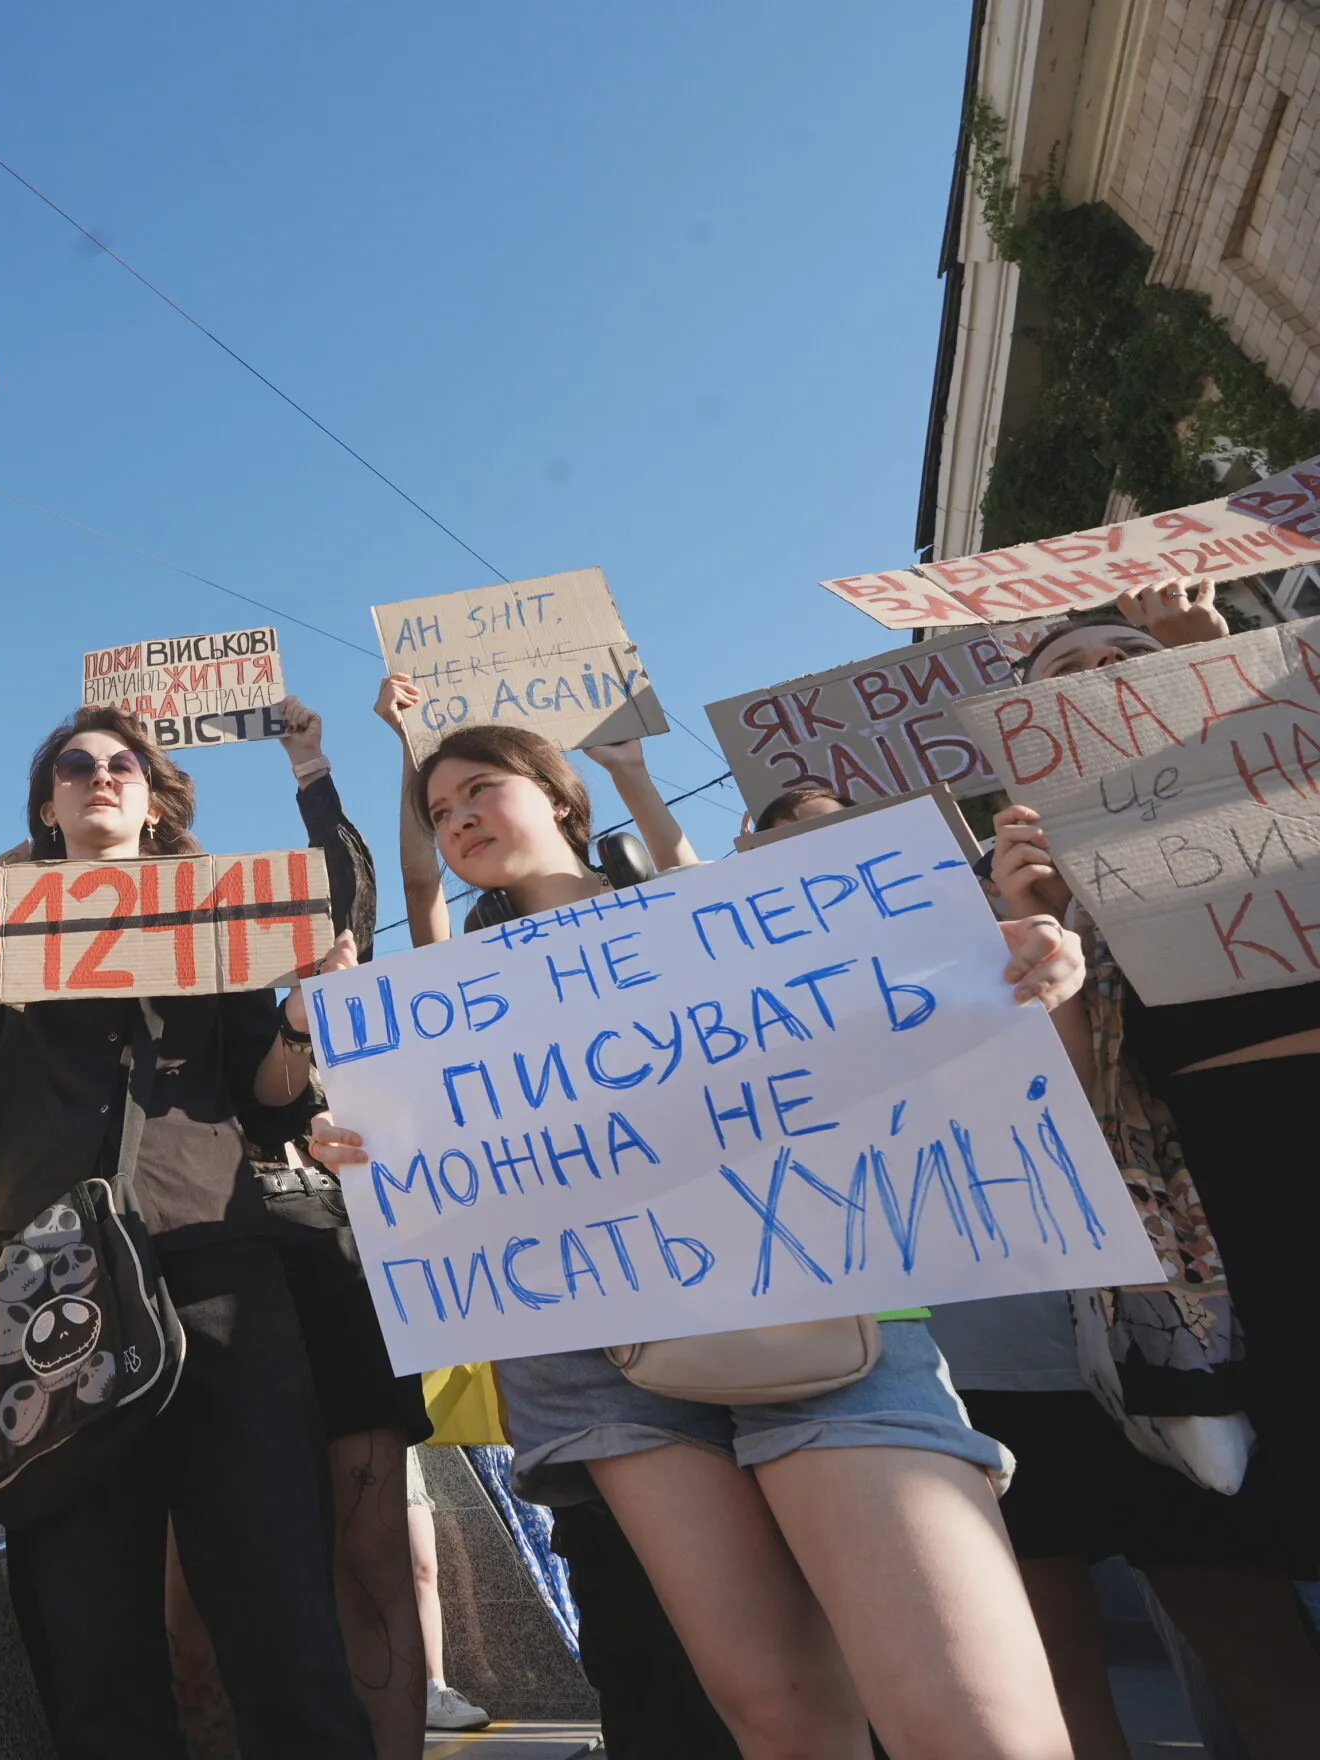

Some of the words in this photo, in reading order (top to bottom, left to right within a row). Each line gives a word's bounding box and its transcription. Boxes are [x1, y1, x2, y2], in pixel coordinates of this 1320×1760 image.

[1152, 513, 1214, 541] Я
[867, 569, 1119, 623] ЗАКОН
[84, 644, 140, 680] ПОКИ
[146, 628, 276, 667] ВІЙСЬКОВІ
[394, 614, 443, 655] AH
[412, 651, 512, 689] HERE
[526, 640, 577, 669] WE
[163, 655, 274, 694] ЖИТТЯ
[421, 695, 469, 731] GO
[492, 663, 638, 718] AGAIN
[742, 686, 847, 755] ЯК
[852, 655, 961, 721] ВИ
[1158, 818, 1305, 889] ВИ
[312, 974, 511, 1068] ШОБ
[546, 932, 661, 1004] НЕ
[692, 850, 969, 961] ПЕРЕ-
[442, 956, 938, 1127] ПИСУВАТЬ
[370, 1111, 661, 1228] МОЖНА
[704, 1069, 840, 1150] НЕ
[381, 1209, 717, 1324] ПИСАТЬ
